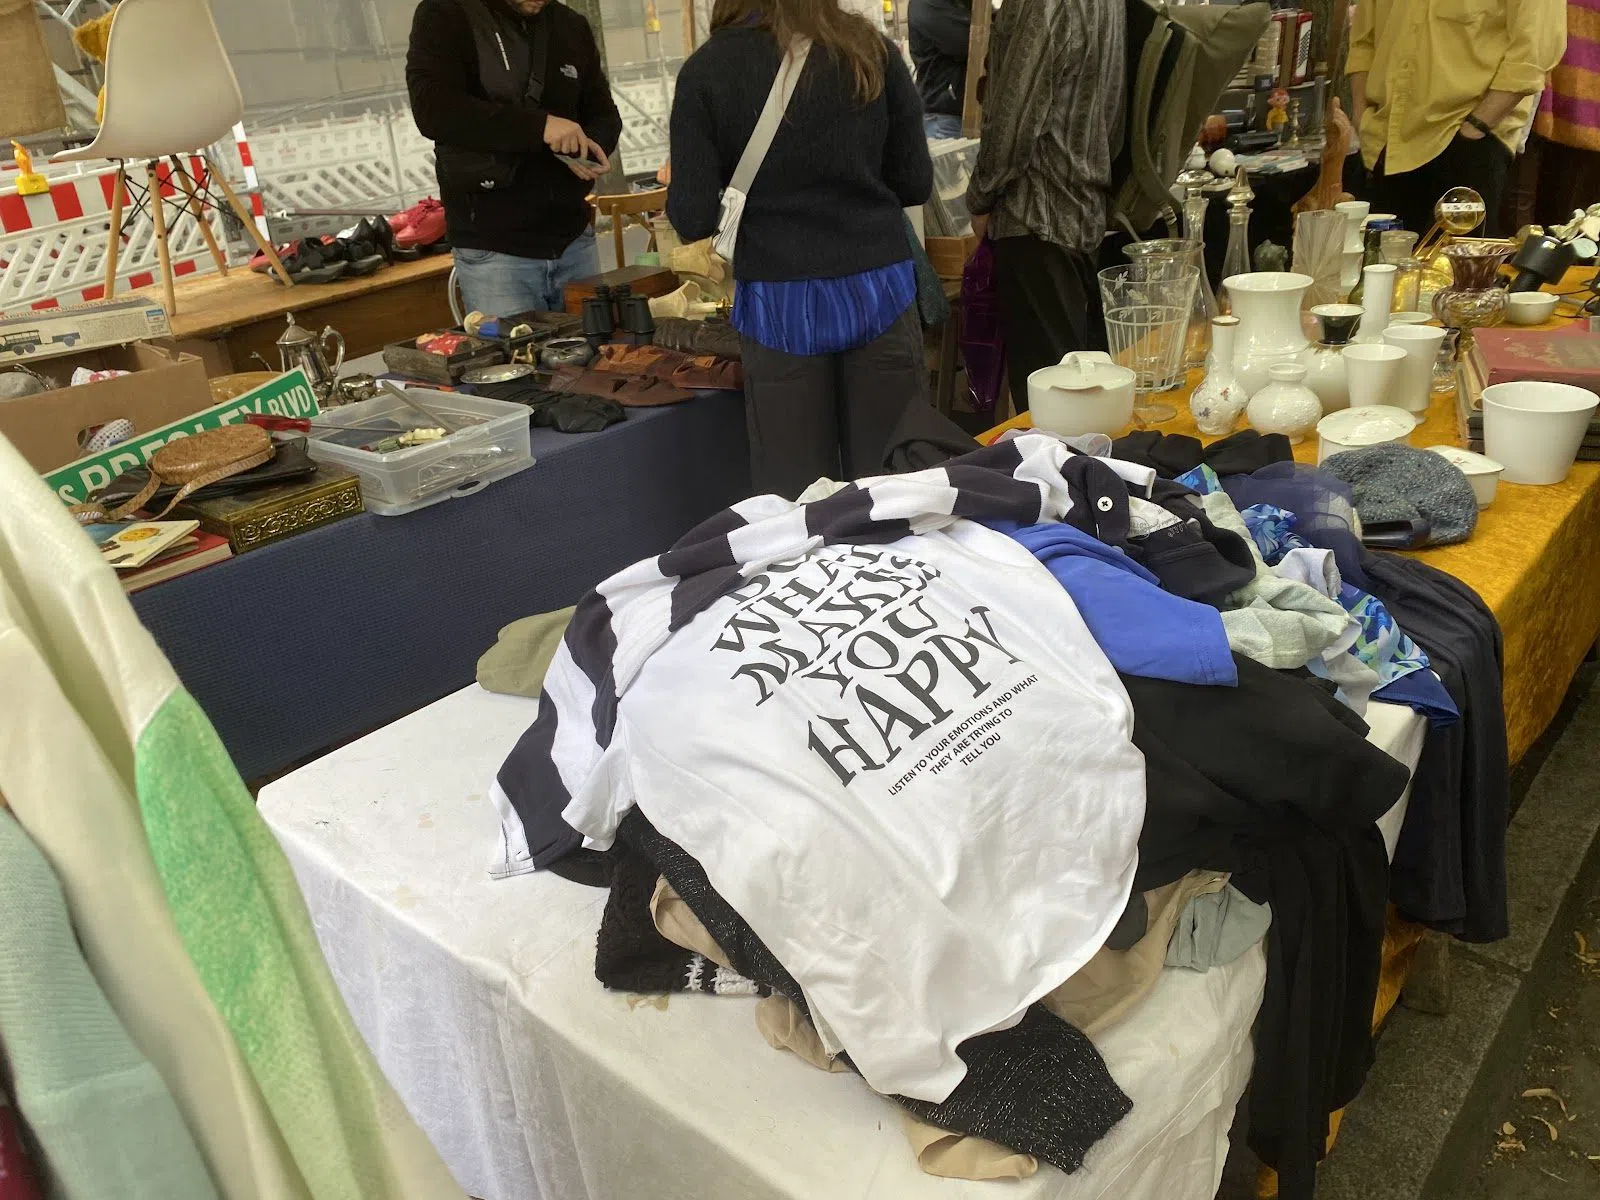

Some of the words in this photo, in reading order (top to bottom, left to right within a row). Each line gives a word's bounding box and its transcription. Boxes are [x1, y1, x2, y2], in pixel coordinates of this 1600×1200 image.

[267, 385, 311, 418] BLVD
[710, 546, 884, 652] WHAT
[802, 596, 938, 698] YOU
[808, 606, 1024, 787] HAPPY
[888, 770, 917, 796] LISTEN
[914, 759, 928, 773] TO
[926, 738, 951, 761] YOUR
[947, 705, 993, 742] EMOTIONS
[992, 691, 1013, 709] AND
[1010, 674, 1039, 696] WHAT
[929, 754, 953, 775] THEY
[954, 738, 971, 757] ARE
[968, 717, 1001, 742] TRYING
[999, 708, 1013, 720] TO
[960, 748, 982, 767] TELL
[980, 732, 1001, 751] YOU
